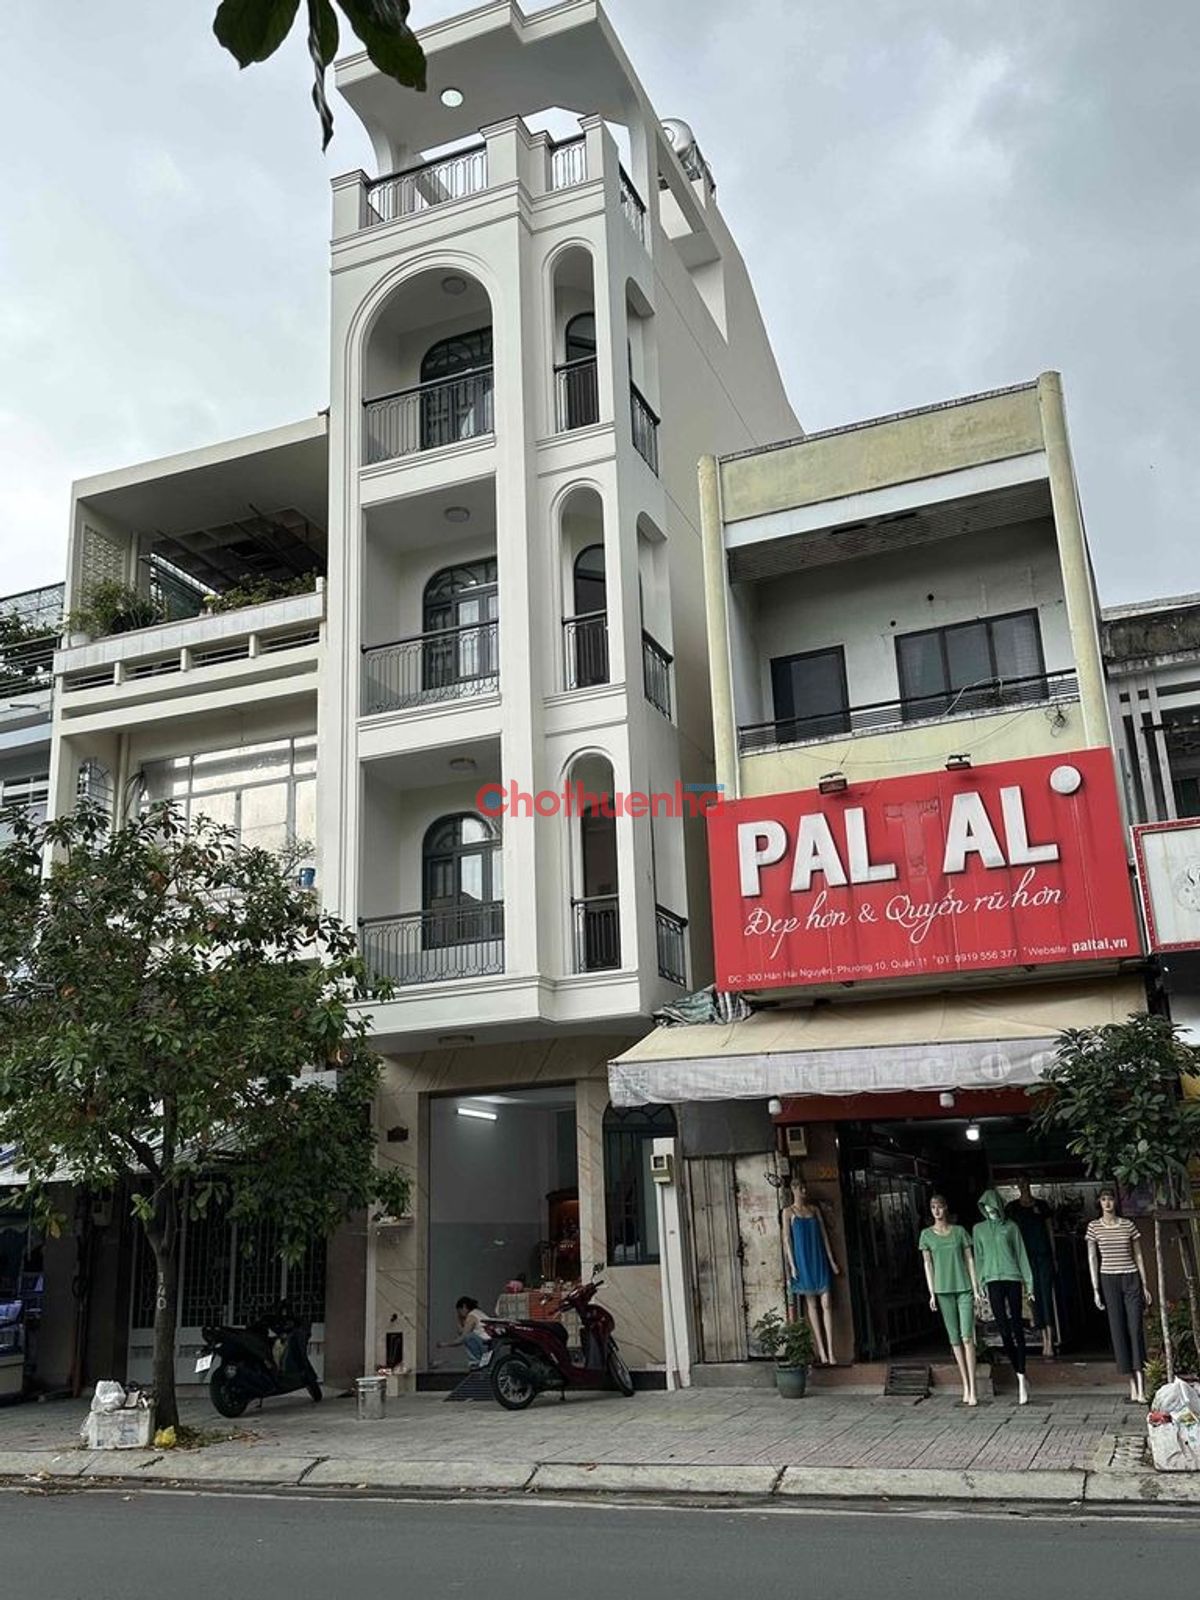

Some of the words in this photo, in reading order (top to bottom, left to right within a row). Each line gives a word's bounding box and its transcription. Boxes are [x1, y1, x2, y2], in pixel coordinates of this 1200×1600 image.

[744, 907, 800, 960] Đẹp
[805, 890, 851, 930] hơn
[858, 903, 878, 923] &
[886, 889, 970, 944] Quyến
[1011, 867, 1061, 908] hơn
[955, 952, 978, 963] 0919
[980, 950, 998, 961] 556
[1000, 948, 1017, 959] 377
